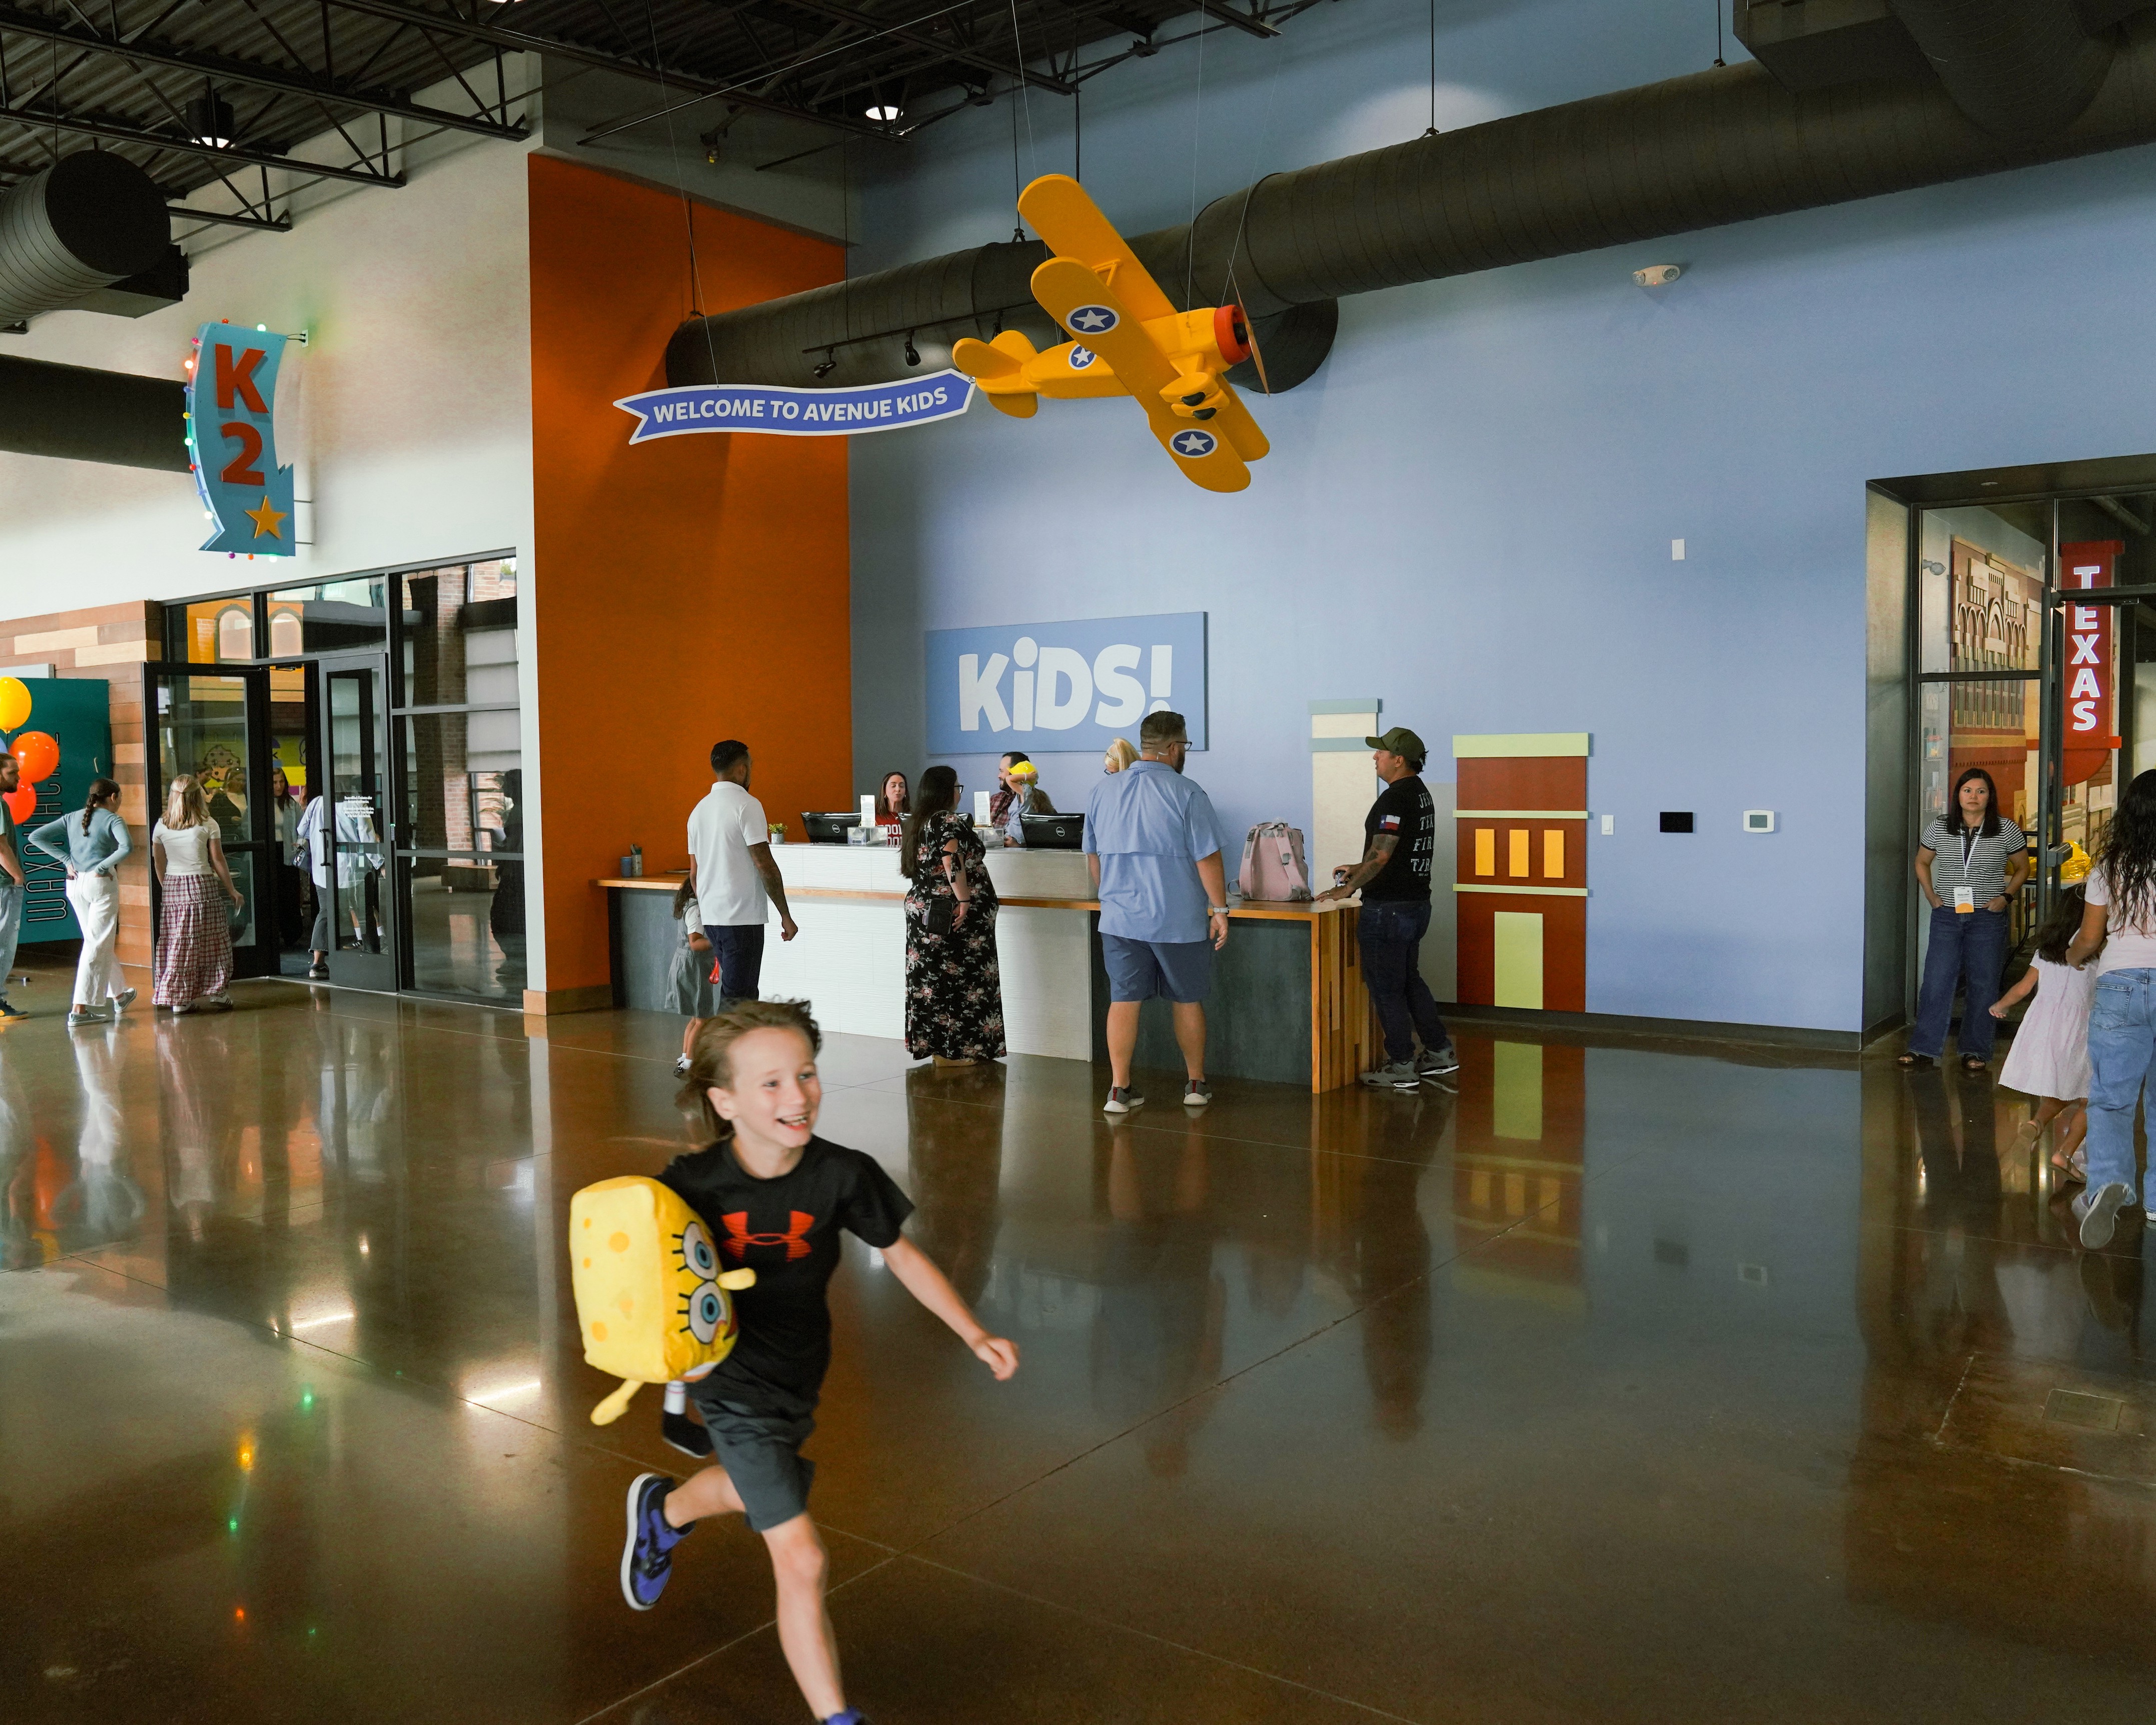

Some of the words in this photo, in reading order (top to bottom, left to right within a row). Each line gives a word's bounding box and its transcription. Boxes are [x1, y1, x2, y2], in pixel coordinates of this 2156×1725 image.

[653, 399, 765, 423] WELCOME
[770, 401, 799, 420] TO
[803, 399, 891, 421] AVENUE
[897, 387, 948, 414] KIDS
[2070, 566, 2100, 731] TEXAS
[1420, 813, 1434, 830] TEX
[1413, 836, 1432, 851] FIR
[1410, 858, 1432, 872] TIR
